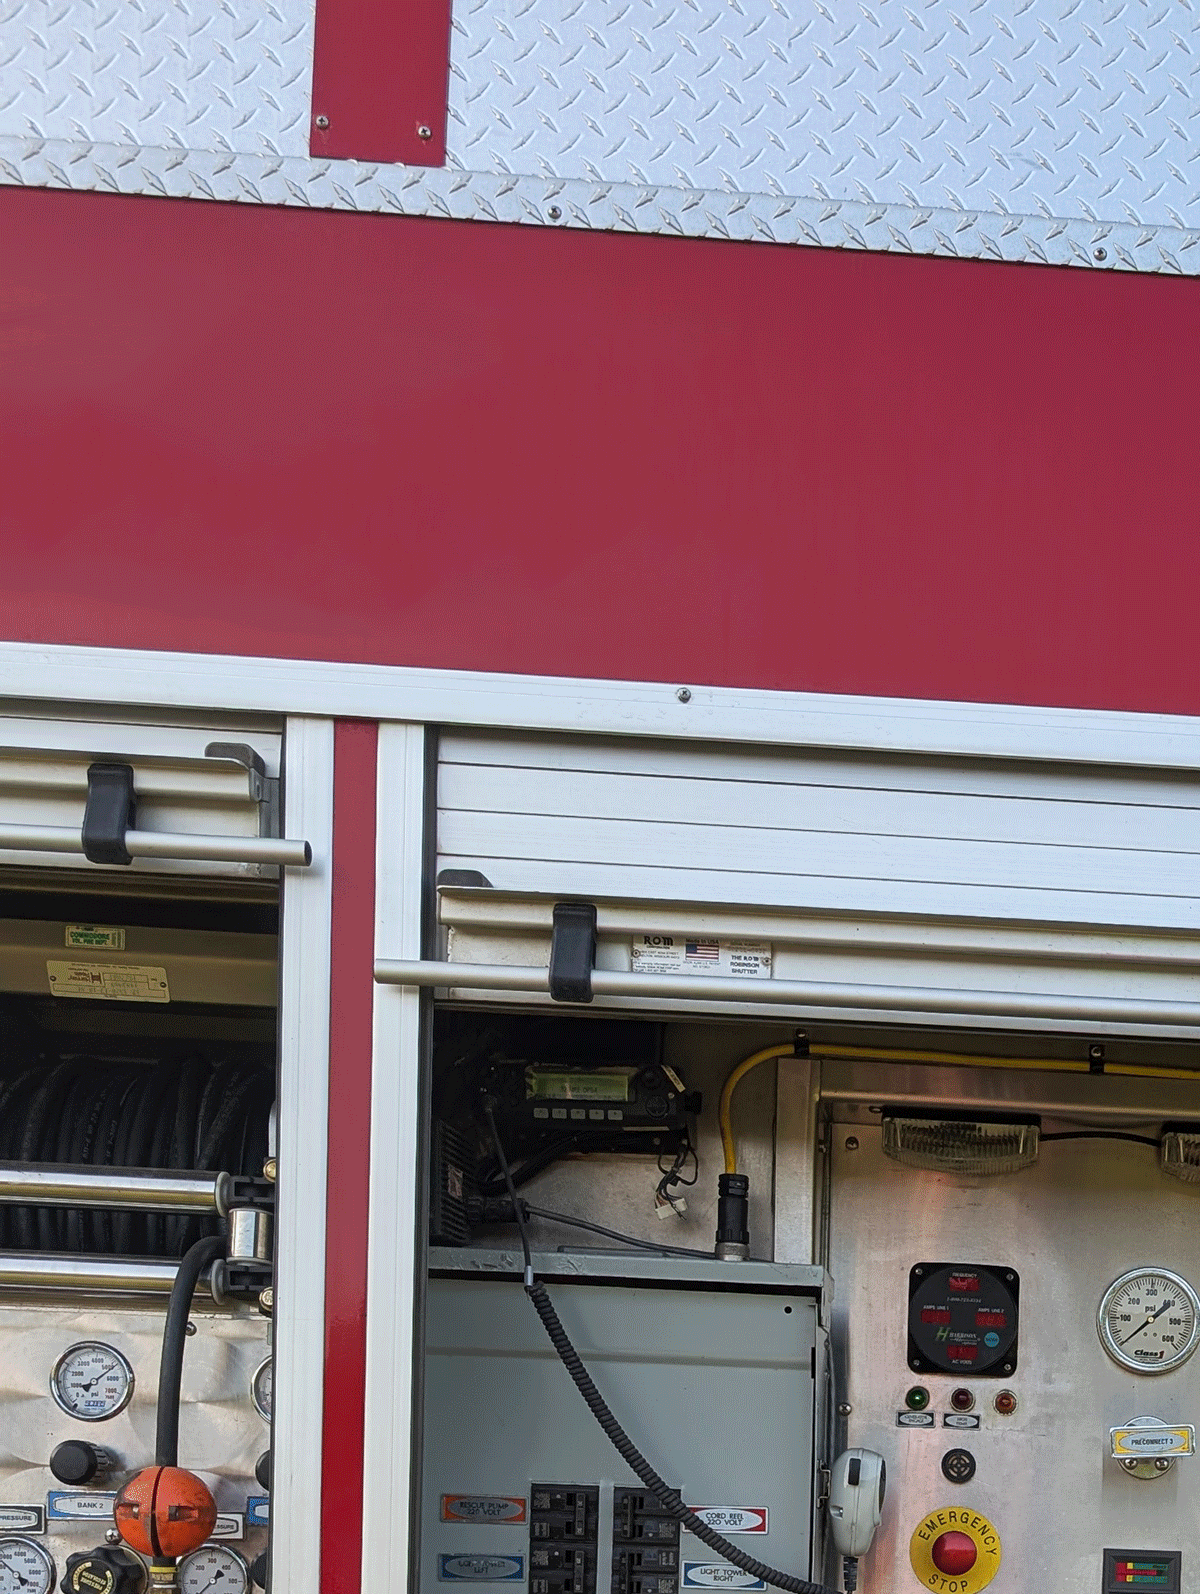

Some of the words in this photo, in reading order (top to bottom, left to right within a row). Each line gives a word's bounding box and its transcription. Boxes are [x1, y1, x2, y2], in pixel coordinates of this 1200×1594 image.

[1131, 1438, 1168, 1446] PRECONNECT
[460, 1502, 487, 1510] RESCUE
[488, 1502, 509, 1510] PUMP
[483, 1508, 501, 1516] VOLT
[918, 1511, 998, 1556] EMERGENCY
[700, 1568, 721, 1576] LIGHT
[723, 1569, 748, 1577] TOWER
[928, 1573, 968, 1593] STOP
